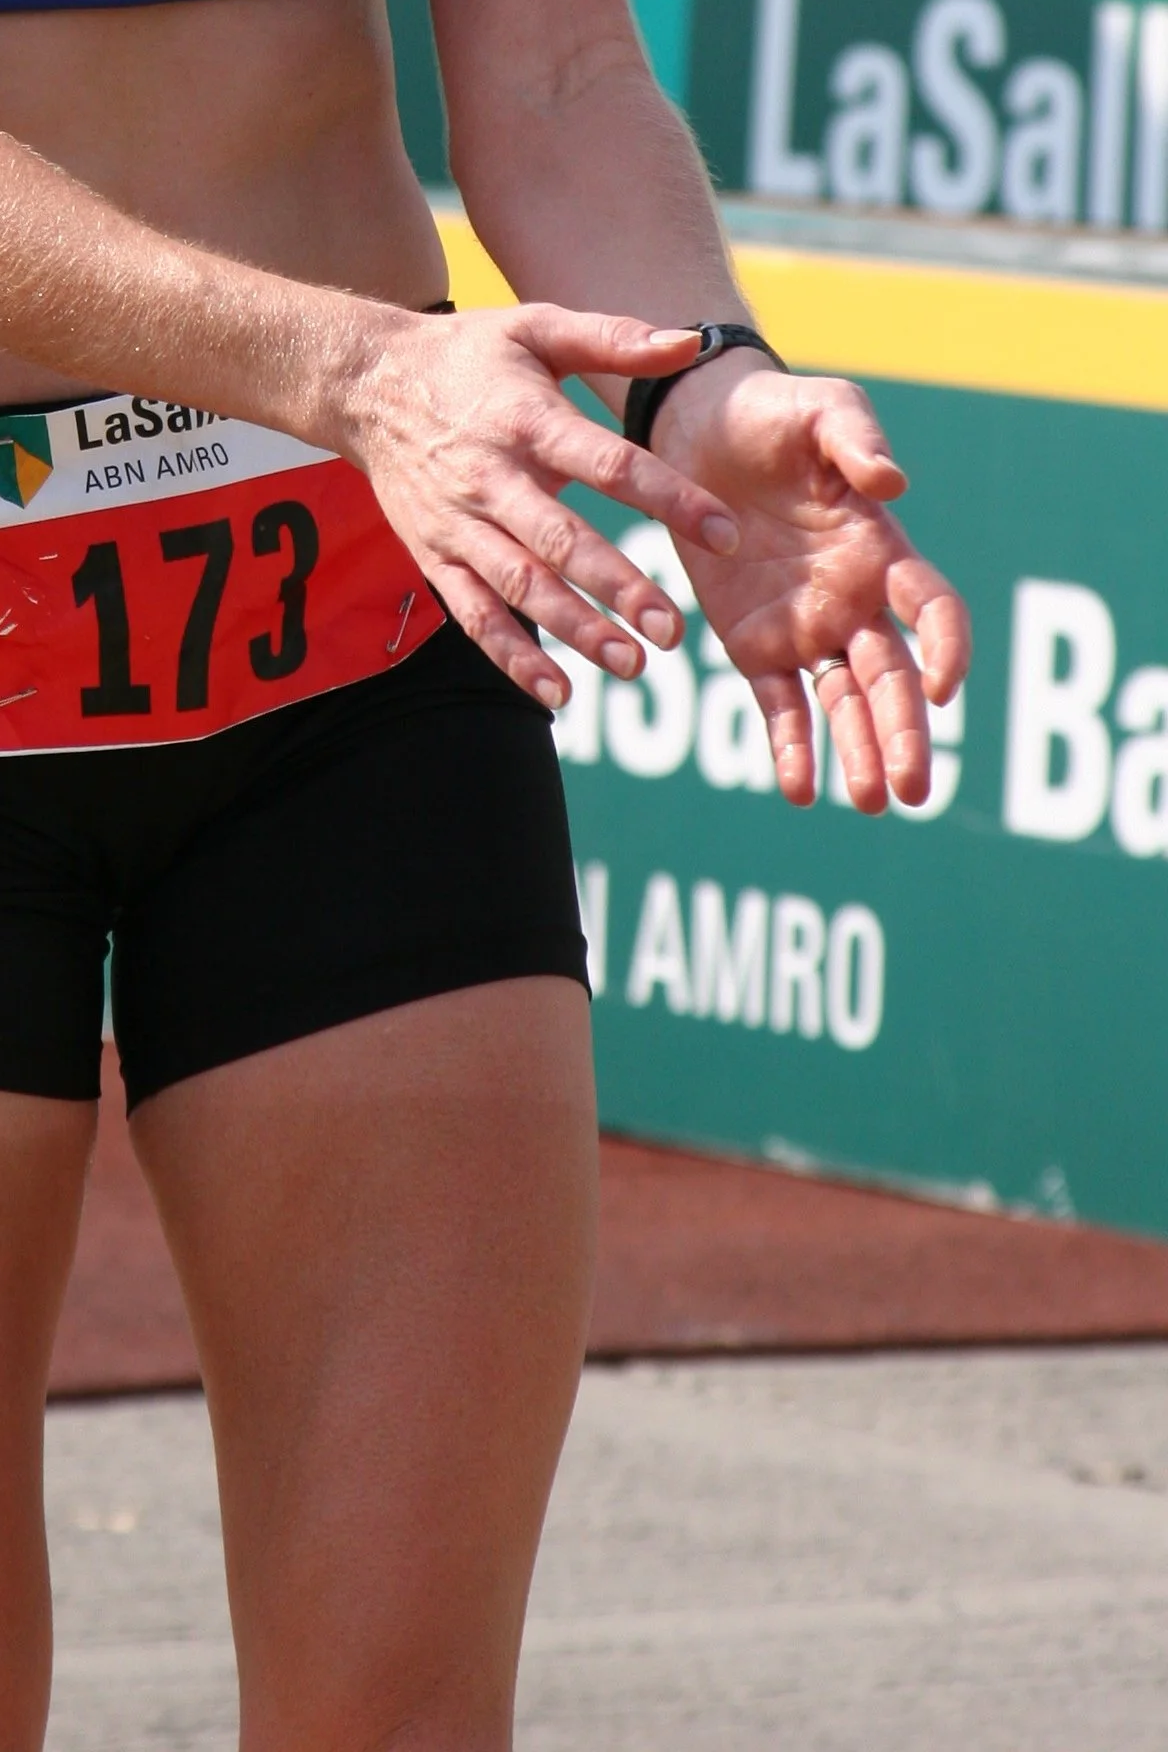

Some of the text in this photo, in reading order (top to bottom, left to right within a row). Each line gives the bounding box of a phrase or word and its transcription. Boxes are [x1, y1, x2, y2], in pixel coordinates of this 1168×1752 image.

[84, 441, 230, 494] ABN AMRO
[71, 499, 320, 718] 173
[626, 869, 886, 1052] AMRO
